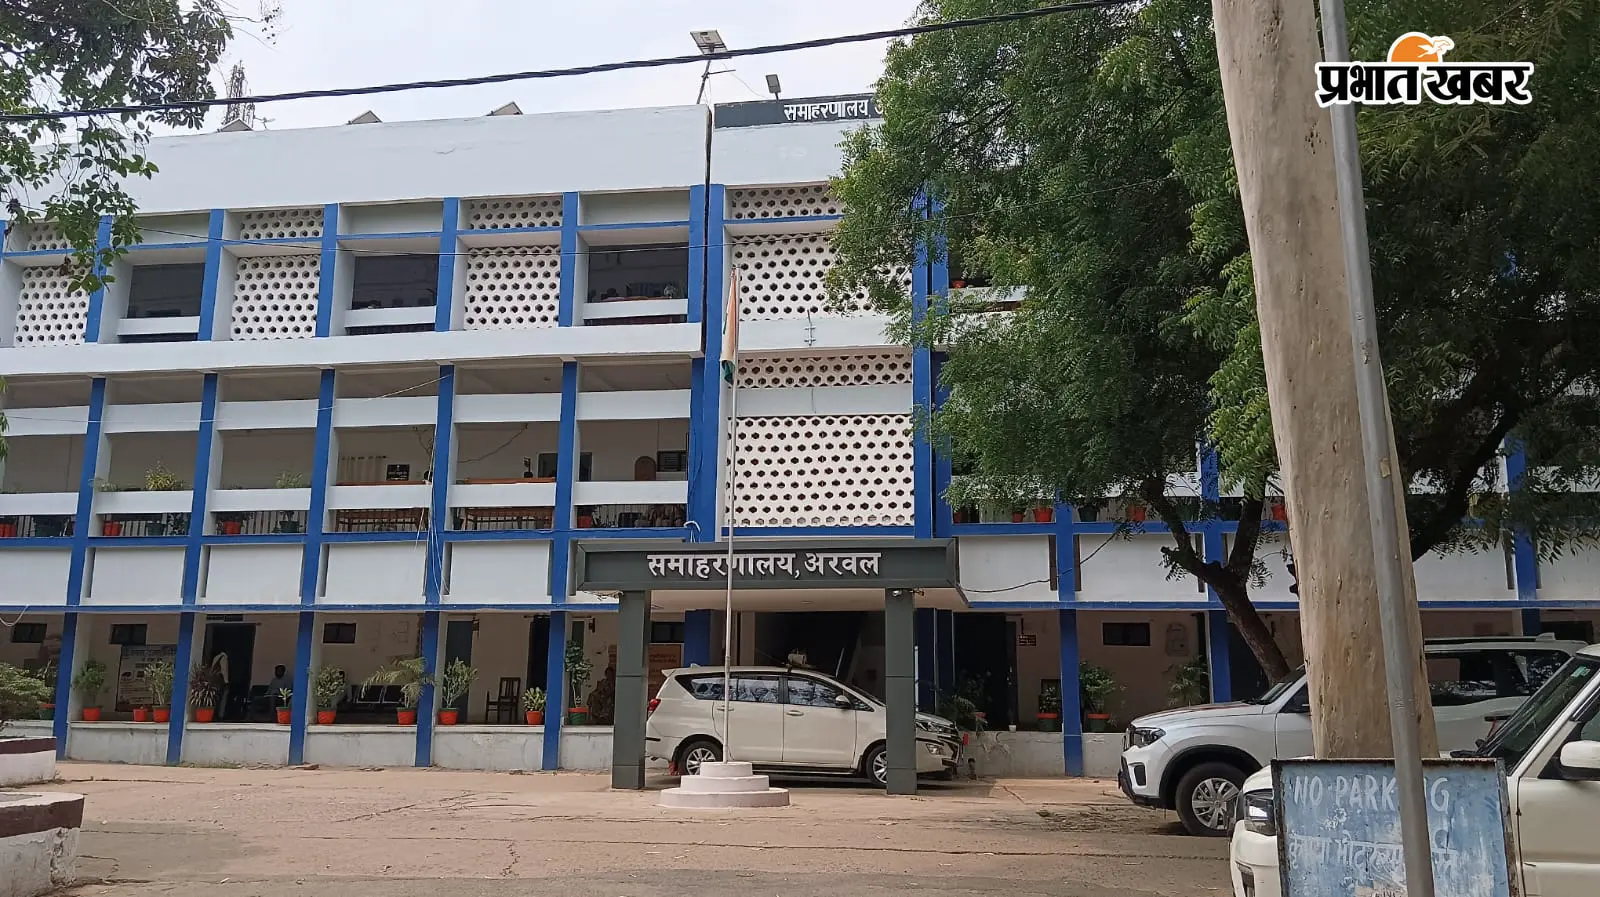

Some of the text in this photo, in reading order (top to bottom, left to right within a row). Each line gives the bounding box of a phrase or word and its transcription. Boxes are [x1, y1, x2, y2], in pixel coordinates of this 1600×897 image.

[804, 552, 882, 576] अरवल
[1294, 774, 1450, 815] NO PARKG
